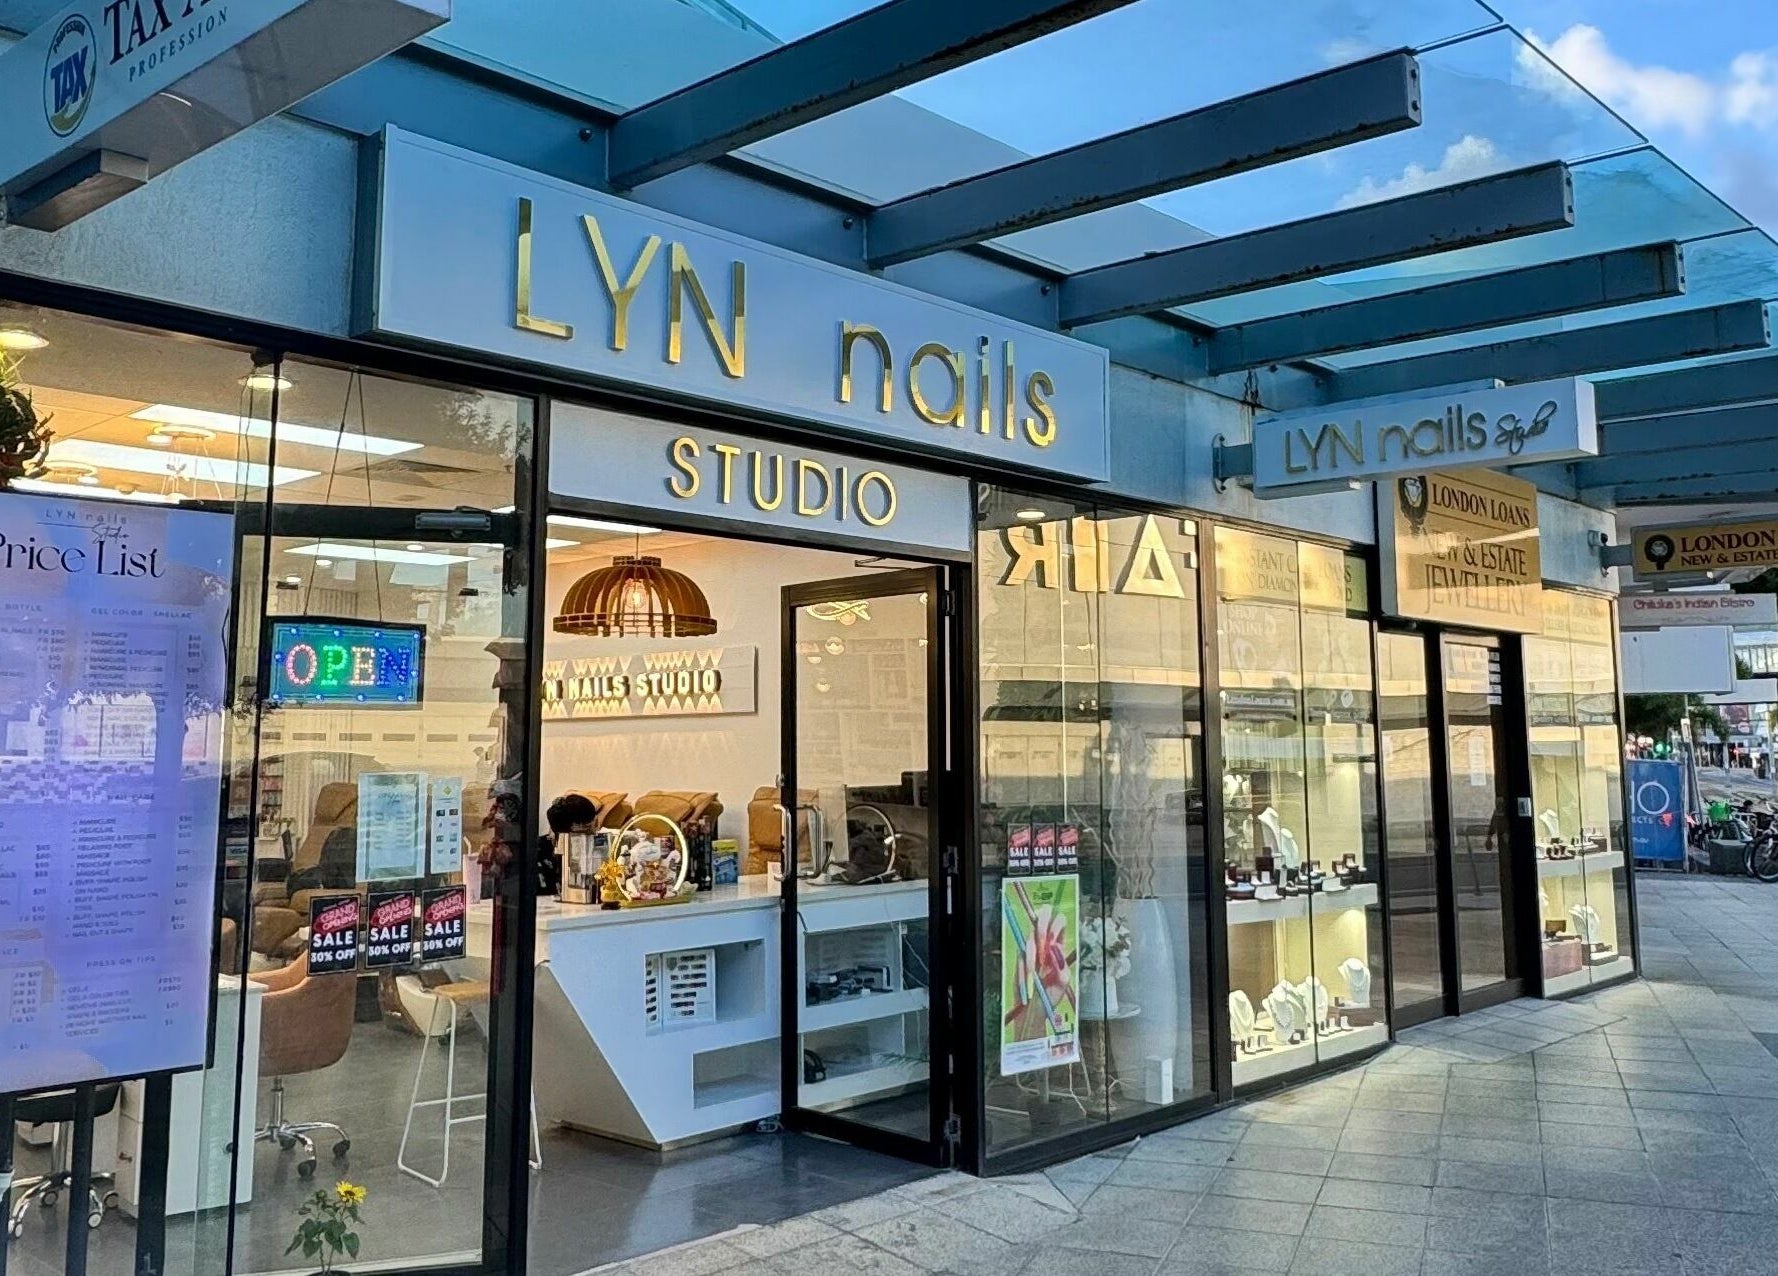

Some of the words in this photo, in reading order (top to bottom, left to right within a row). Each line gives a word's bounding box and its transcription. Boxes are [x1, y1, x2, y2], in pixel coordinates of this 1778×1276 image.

[104, 0, 173, 65] TAX
[129, 6, 228, 82] PROFESSION
[51, 45, 88, 114] TAX
[514, 197, 746, 378] LYN
[839, 320, 1056, 447] nails
[1285, 420, 1364, 473] LYN
[1378, 404, 1487, 462] nails
[669, 436, 897, 527] STUDIO
[1432, 483, 1488, 519] LONDON
[1491, 499, 1530, 528] LOANS
[97, 540, 167, 578] List
[1463, 537, 1478, 567] &
[1480, 543, 1527, 576] ESTATE
[1680, 530, 1776, 553] LONDON
[1681, 554, 1712, 566] NEW
[1716, 553, 1729, 563] &
[1425, 564, 1529, 616] JEWELLERY
[285, 644, 411, 685] OPEN
[568, 675, 628, 700] NAILS
[636, 669, 717, 698] STUDIO
[312, 930, 354, 948] SALE
[370, 924, 409, 942] SALE
[424, 919, 461, 936] SALE
[445, 936, 464, 948] OFF
[335, 949, 356, 960] OFF
[391, 941, 412, 954] OFF
